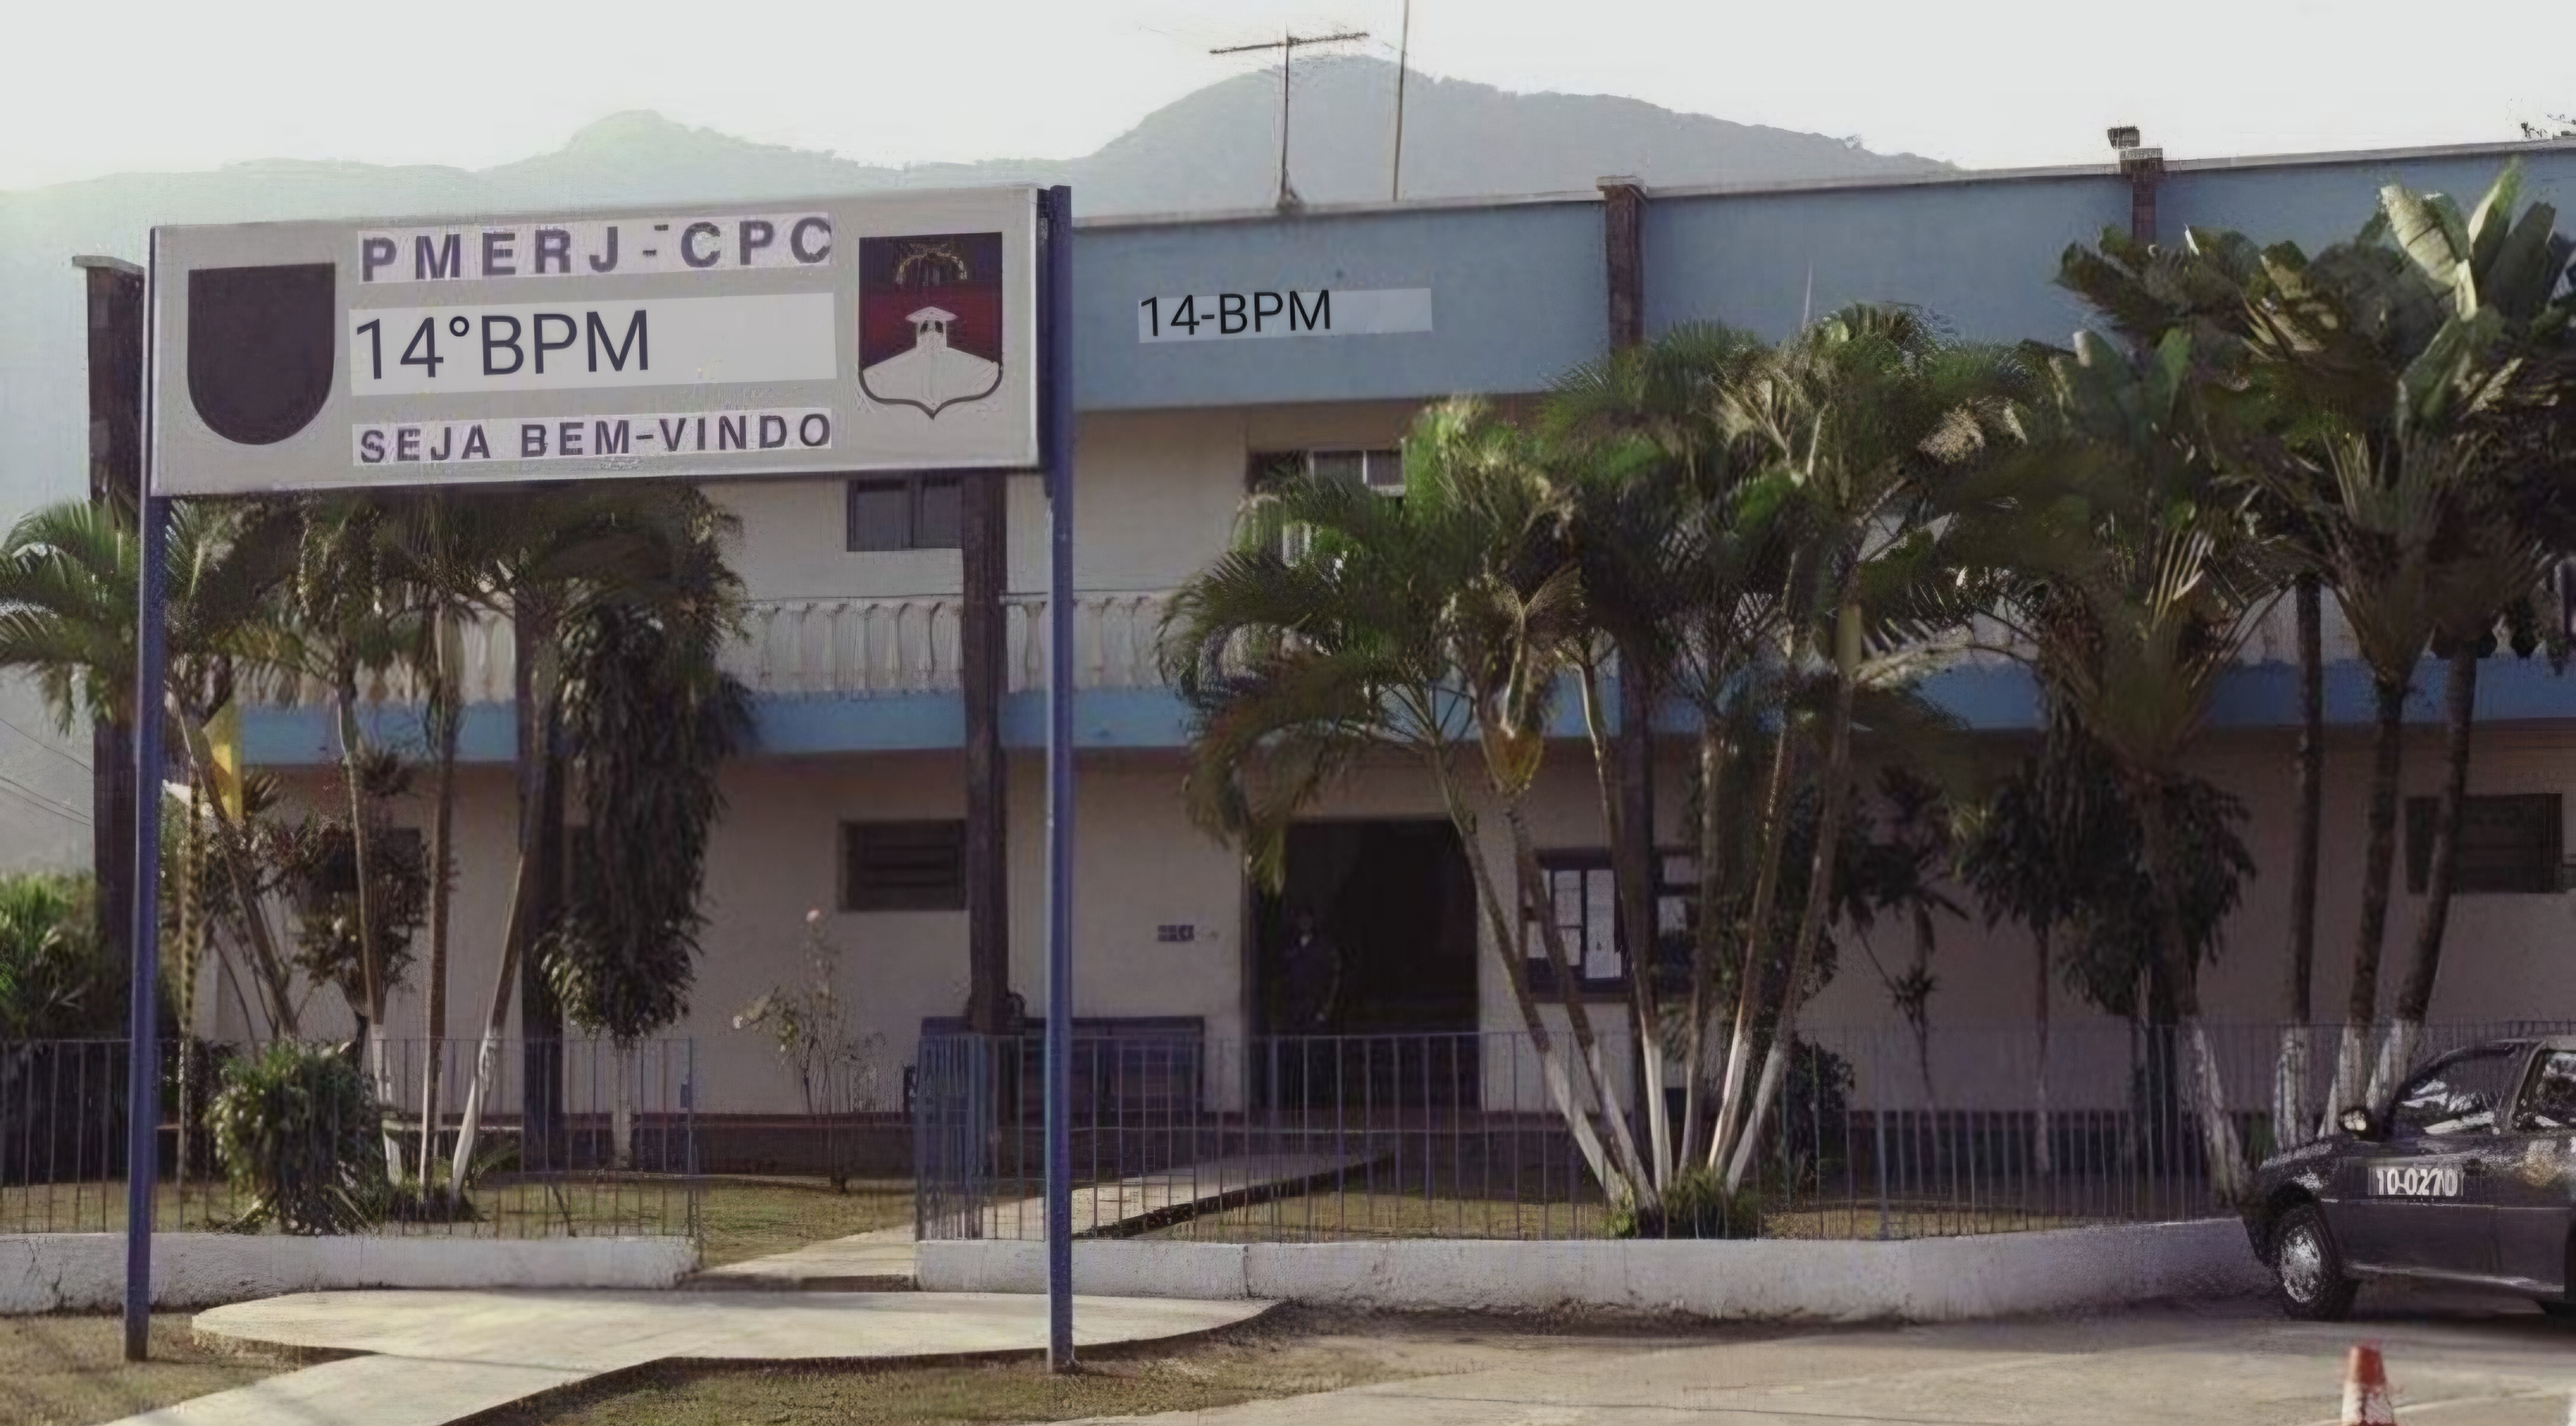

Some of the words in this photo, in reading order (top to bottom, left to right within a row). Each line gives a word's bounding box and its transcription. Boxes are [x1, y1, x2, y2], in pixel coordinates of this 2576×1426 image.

[1141, 290, 1330, 336] 14-BPM
[357, 309, 648, 379] 14°BPM
[361, 424, 491, 463] SEJA
